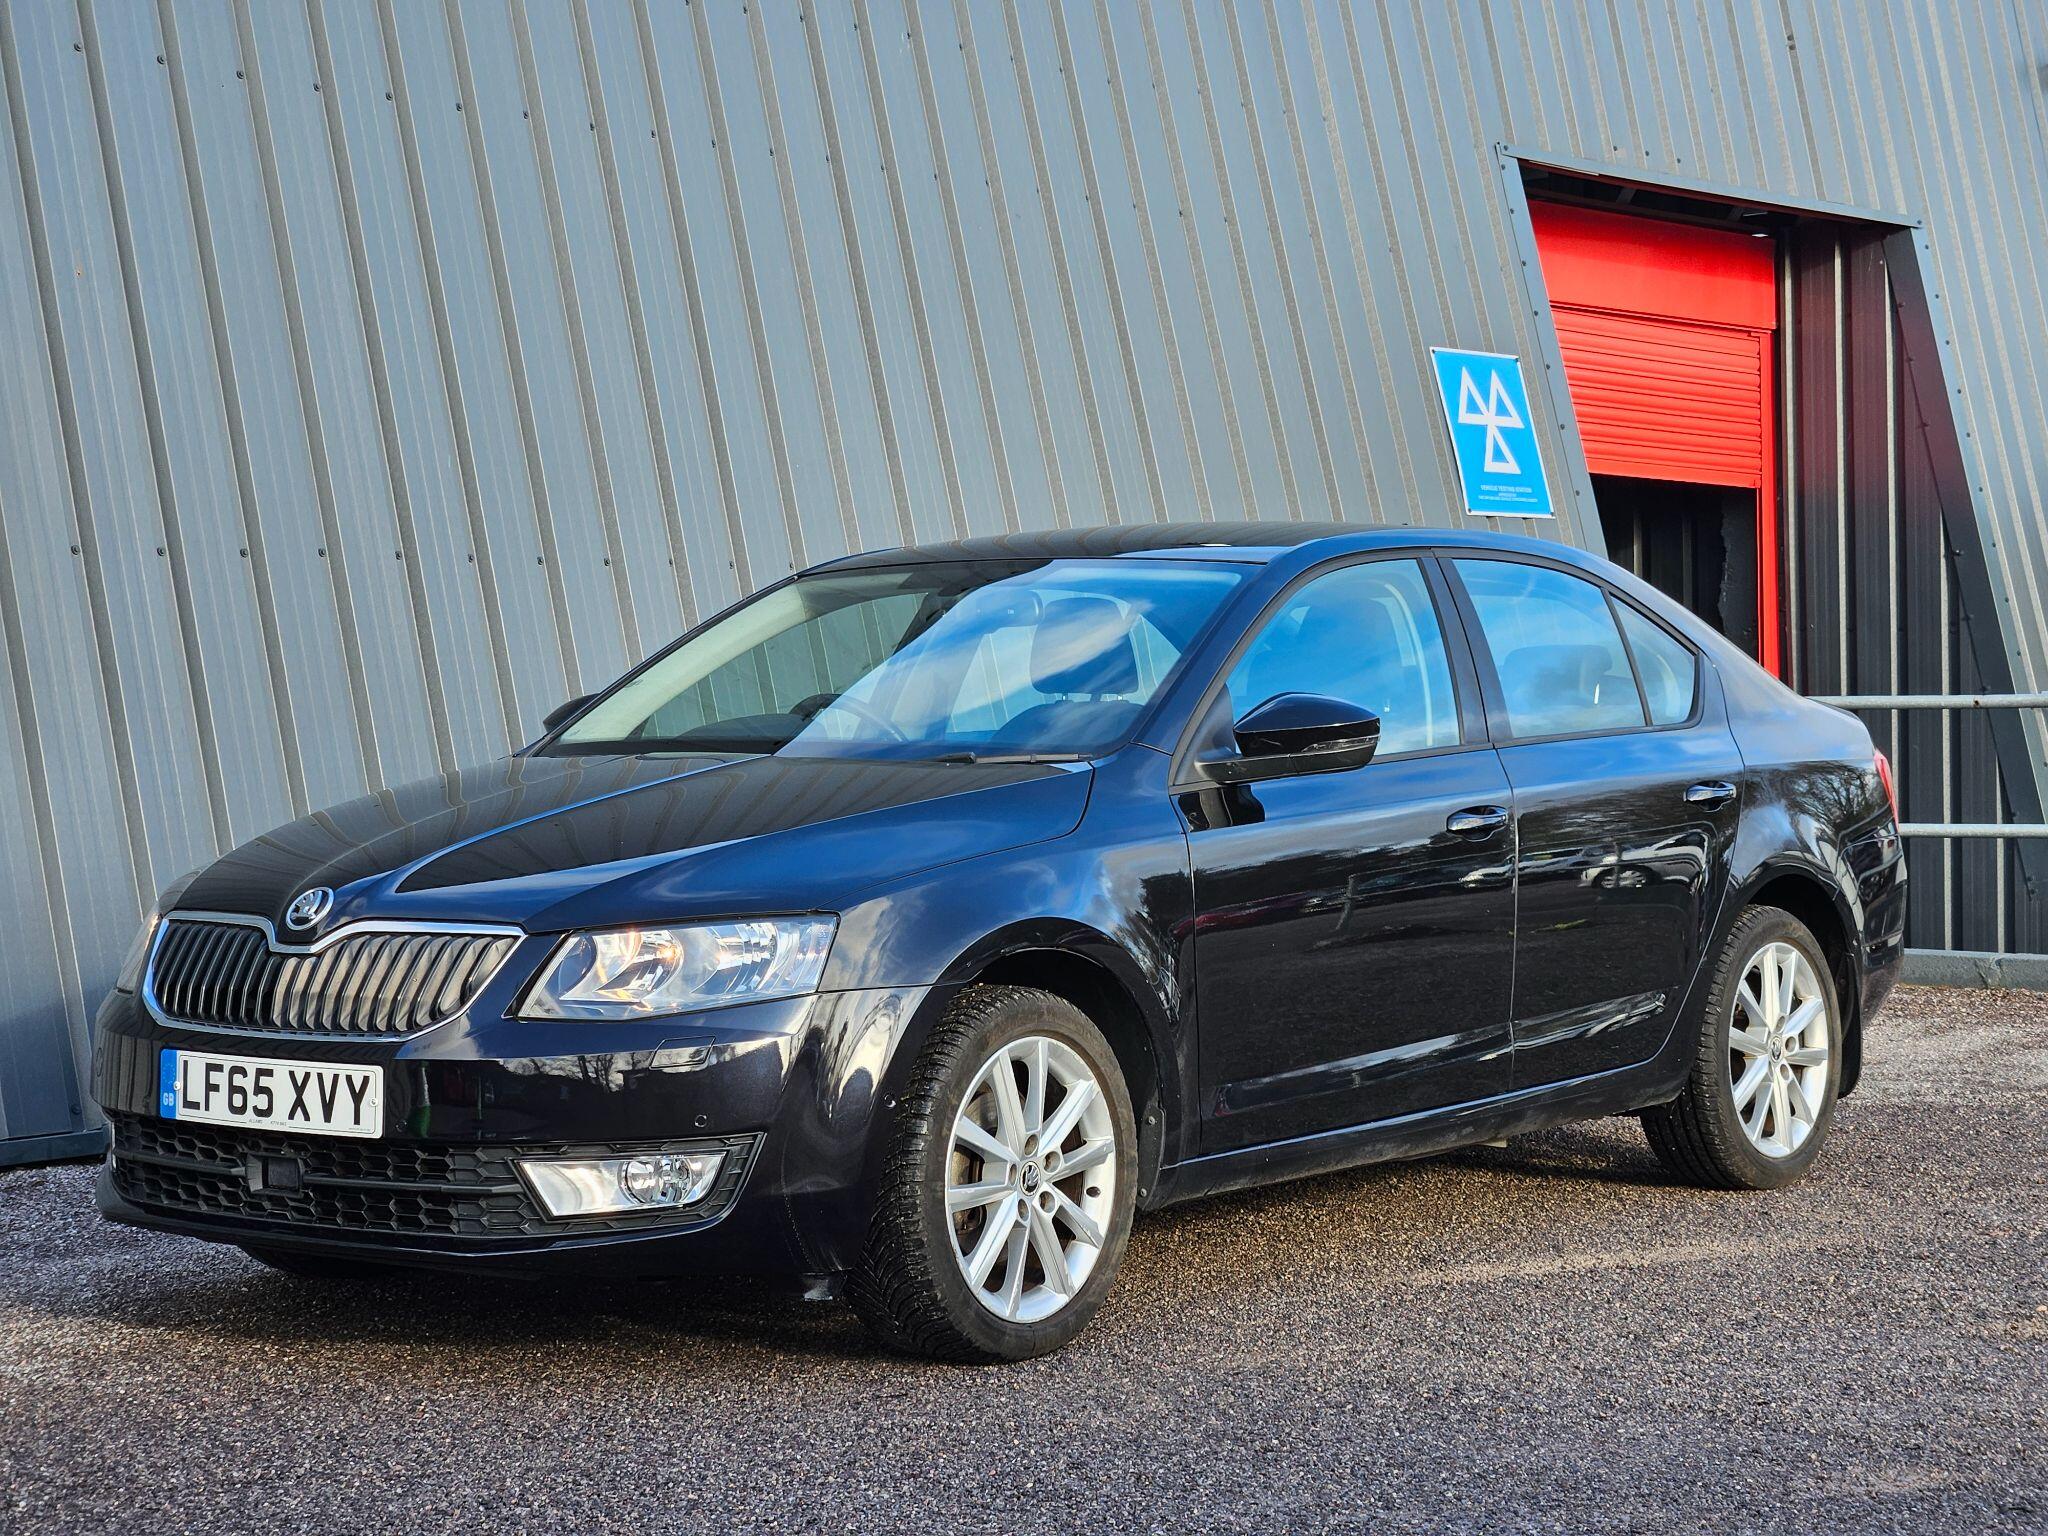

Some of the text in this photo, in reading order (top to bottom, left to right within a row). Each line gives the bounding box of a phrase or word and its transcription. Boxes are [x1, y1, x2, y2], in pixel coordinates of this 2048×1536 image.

[163, 1092, 174, 1106] GB
[182, 1059, 370, 1126] LF65 XVY
